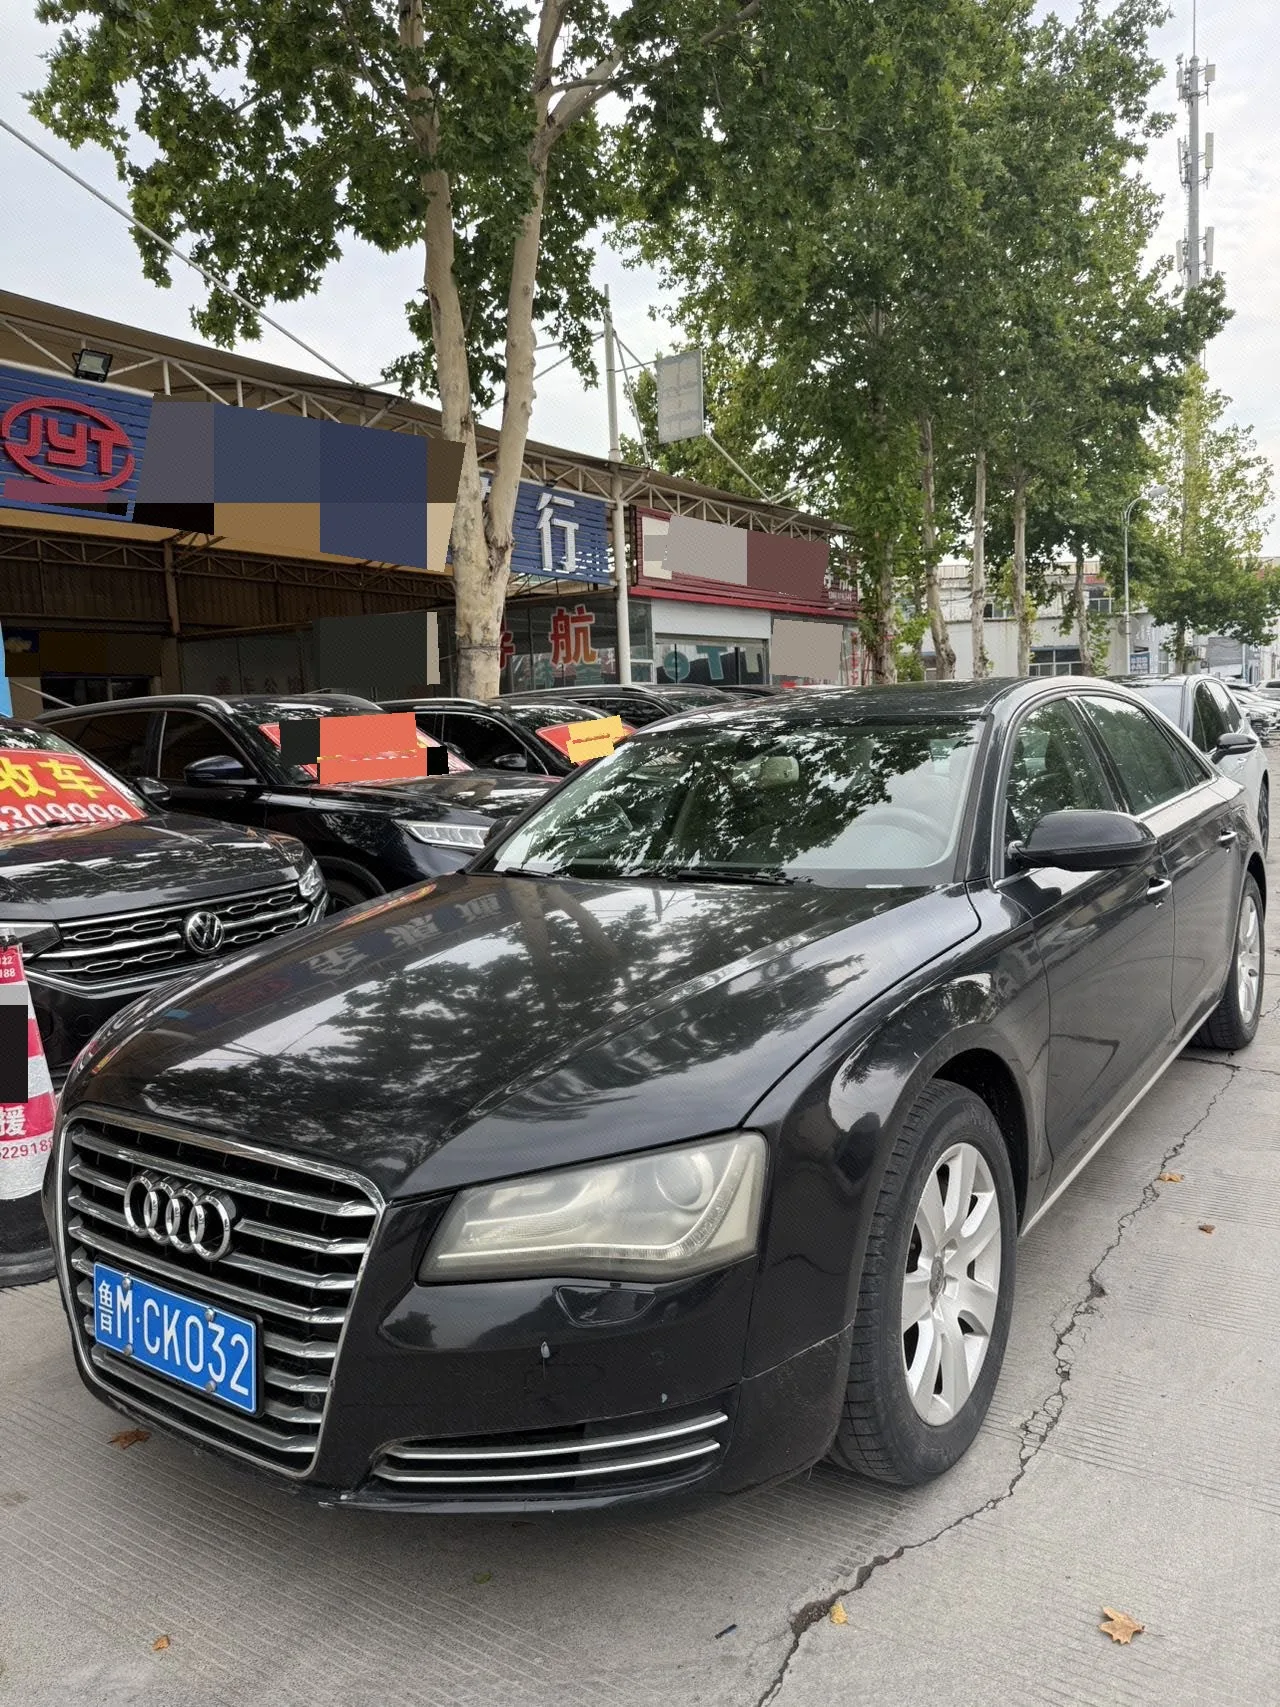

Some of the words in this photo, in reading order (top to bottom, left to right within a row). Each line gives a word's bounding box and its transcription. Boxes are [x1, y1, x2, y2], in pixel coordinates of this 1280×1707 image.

[21, 413, 124, 475] JYT
[536, 492, 579, 573] 行
[0, 1104, 27, 1137] 援
